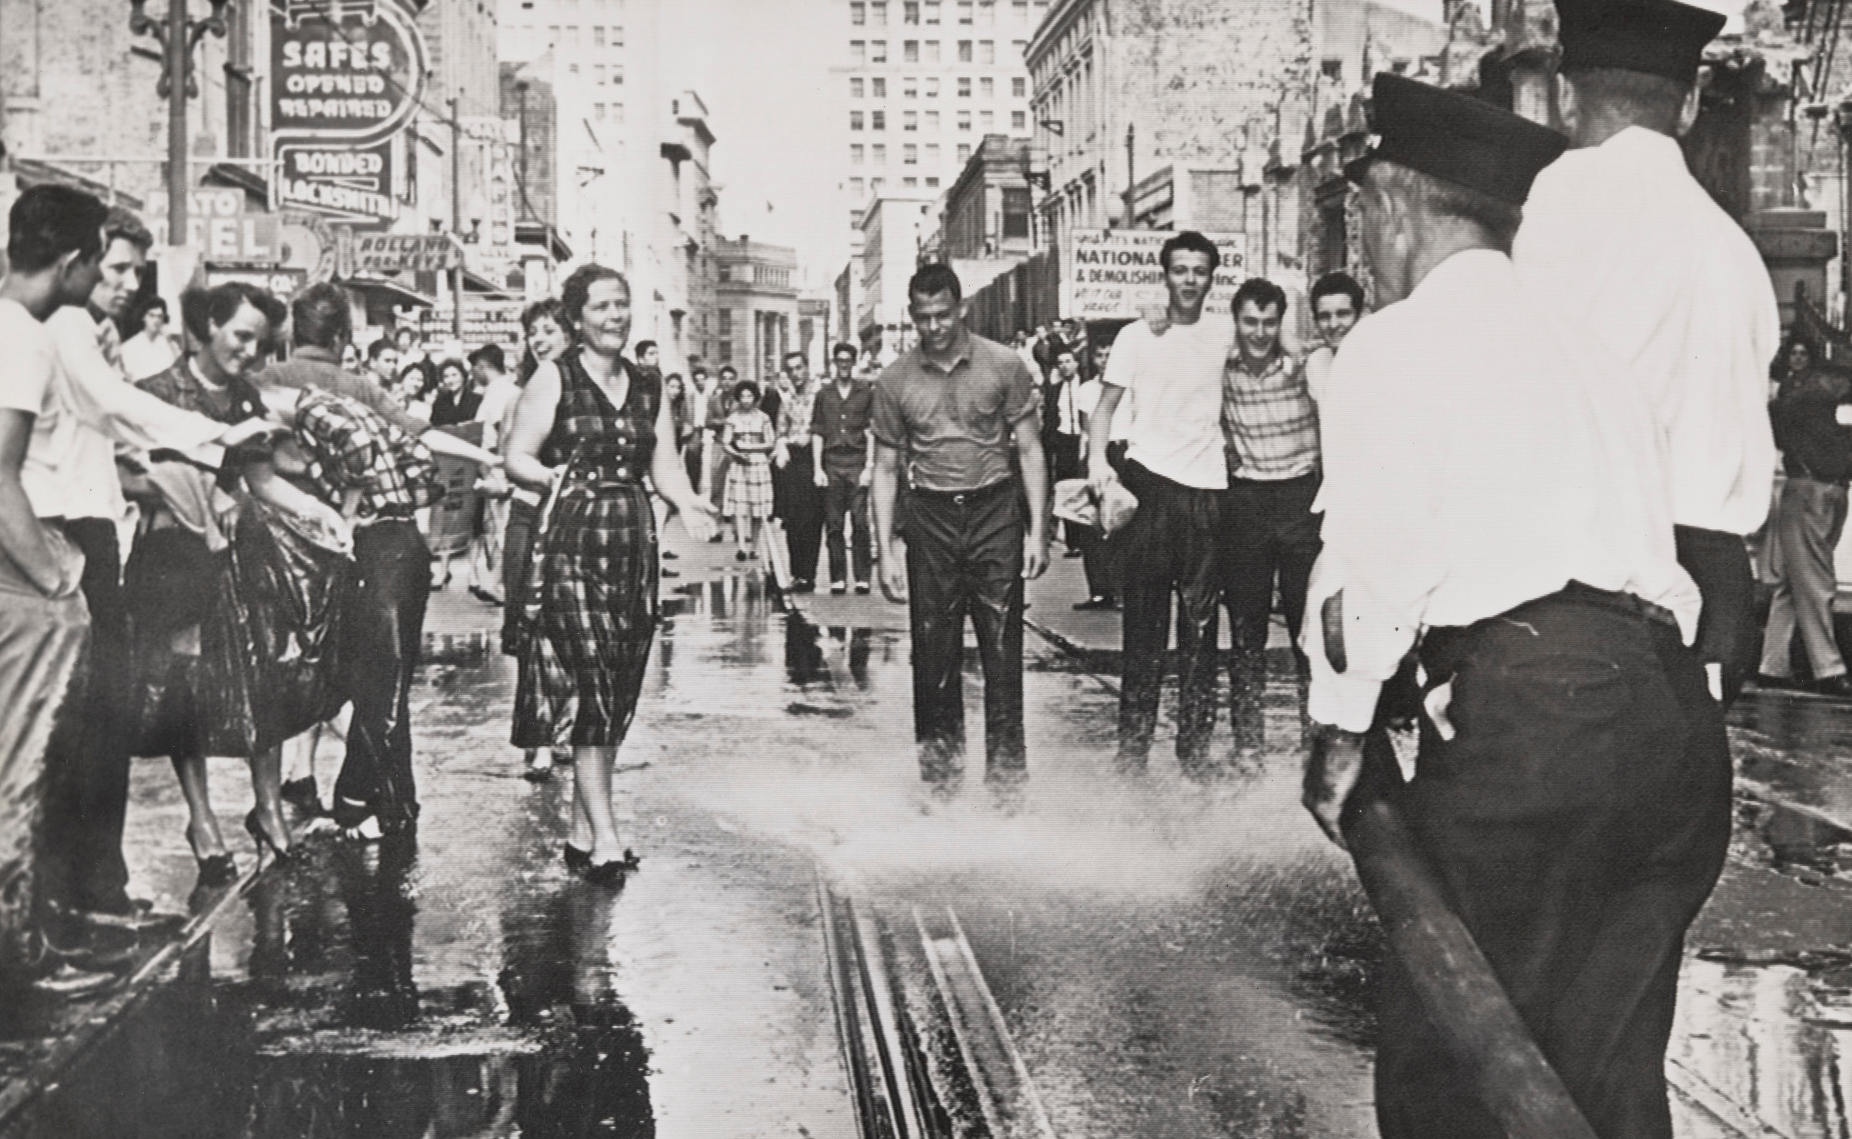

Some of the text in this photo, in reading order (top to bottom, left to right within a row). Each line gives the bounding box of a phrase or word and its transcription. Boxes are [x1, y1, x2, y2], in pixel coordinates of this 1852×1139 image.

[282, 40, 391, 69] SAFES
[286, 74, 385, 93] OPENED
[278, 99, 393, 118] REPAIRED
[294, 152, 383, 174] BONDED
[282, 178, 397, 220] LOCKSMITH
[1076, 248, 1161, 266] NATIONA
[1076, 268, 1085, 283] &
[1089, 269, 1167, 285] DEMOLISHIN
